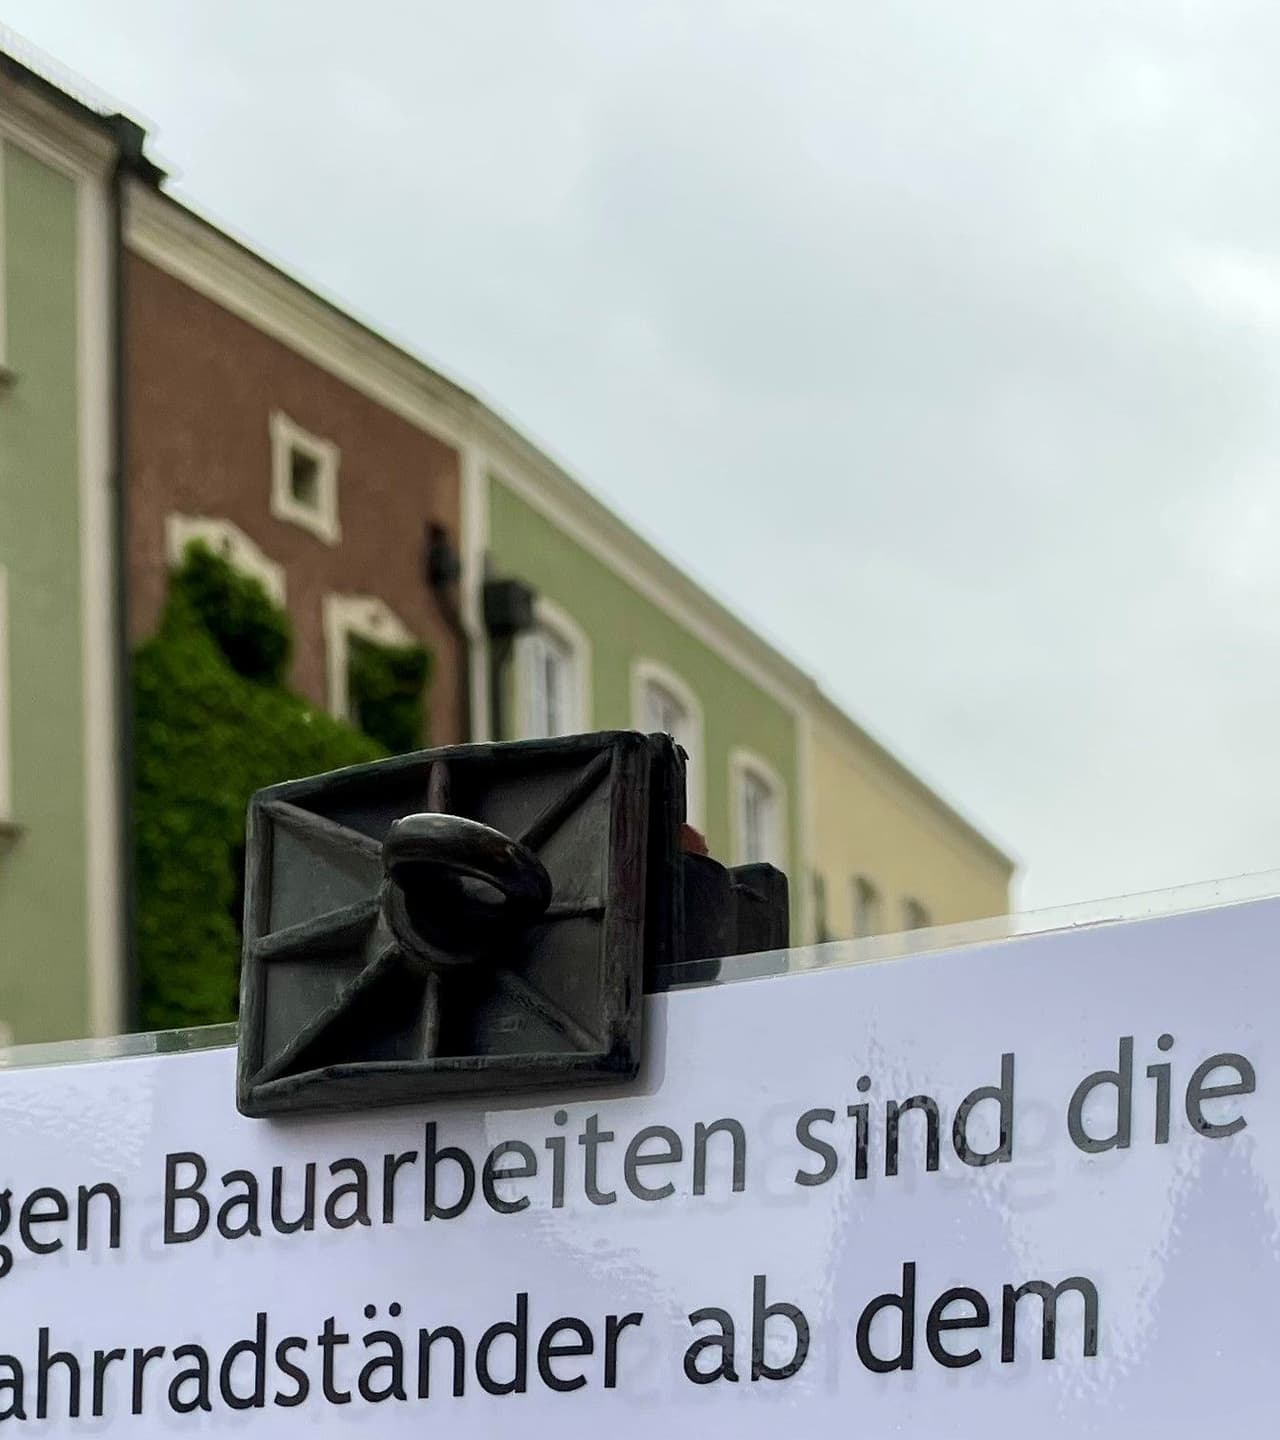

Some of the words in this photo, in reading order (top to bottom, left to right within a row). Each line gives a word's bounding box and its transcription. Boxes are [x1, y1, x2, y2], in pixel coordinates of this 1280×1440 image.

[163, 1108, 747, 1246] Bauarbeiten
[794, 1053, 1015, 1188] sind
[1066, 1033, 1257, 1154] die
[683, 1274, 811, 1386] ab
[855, 1261, 1099, 1374] dem
